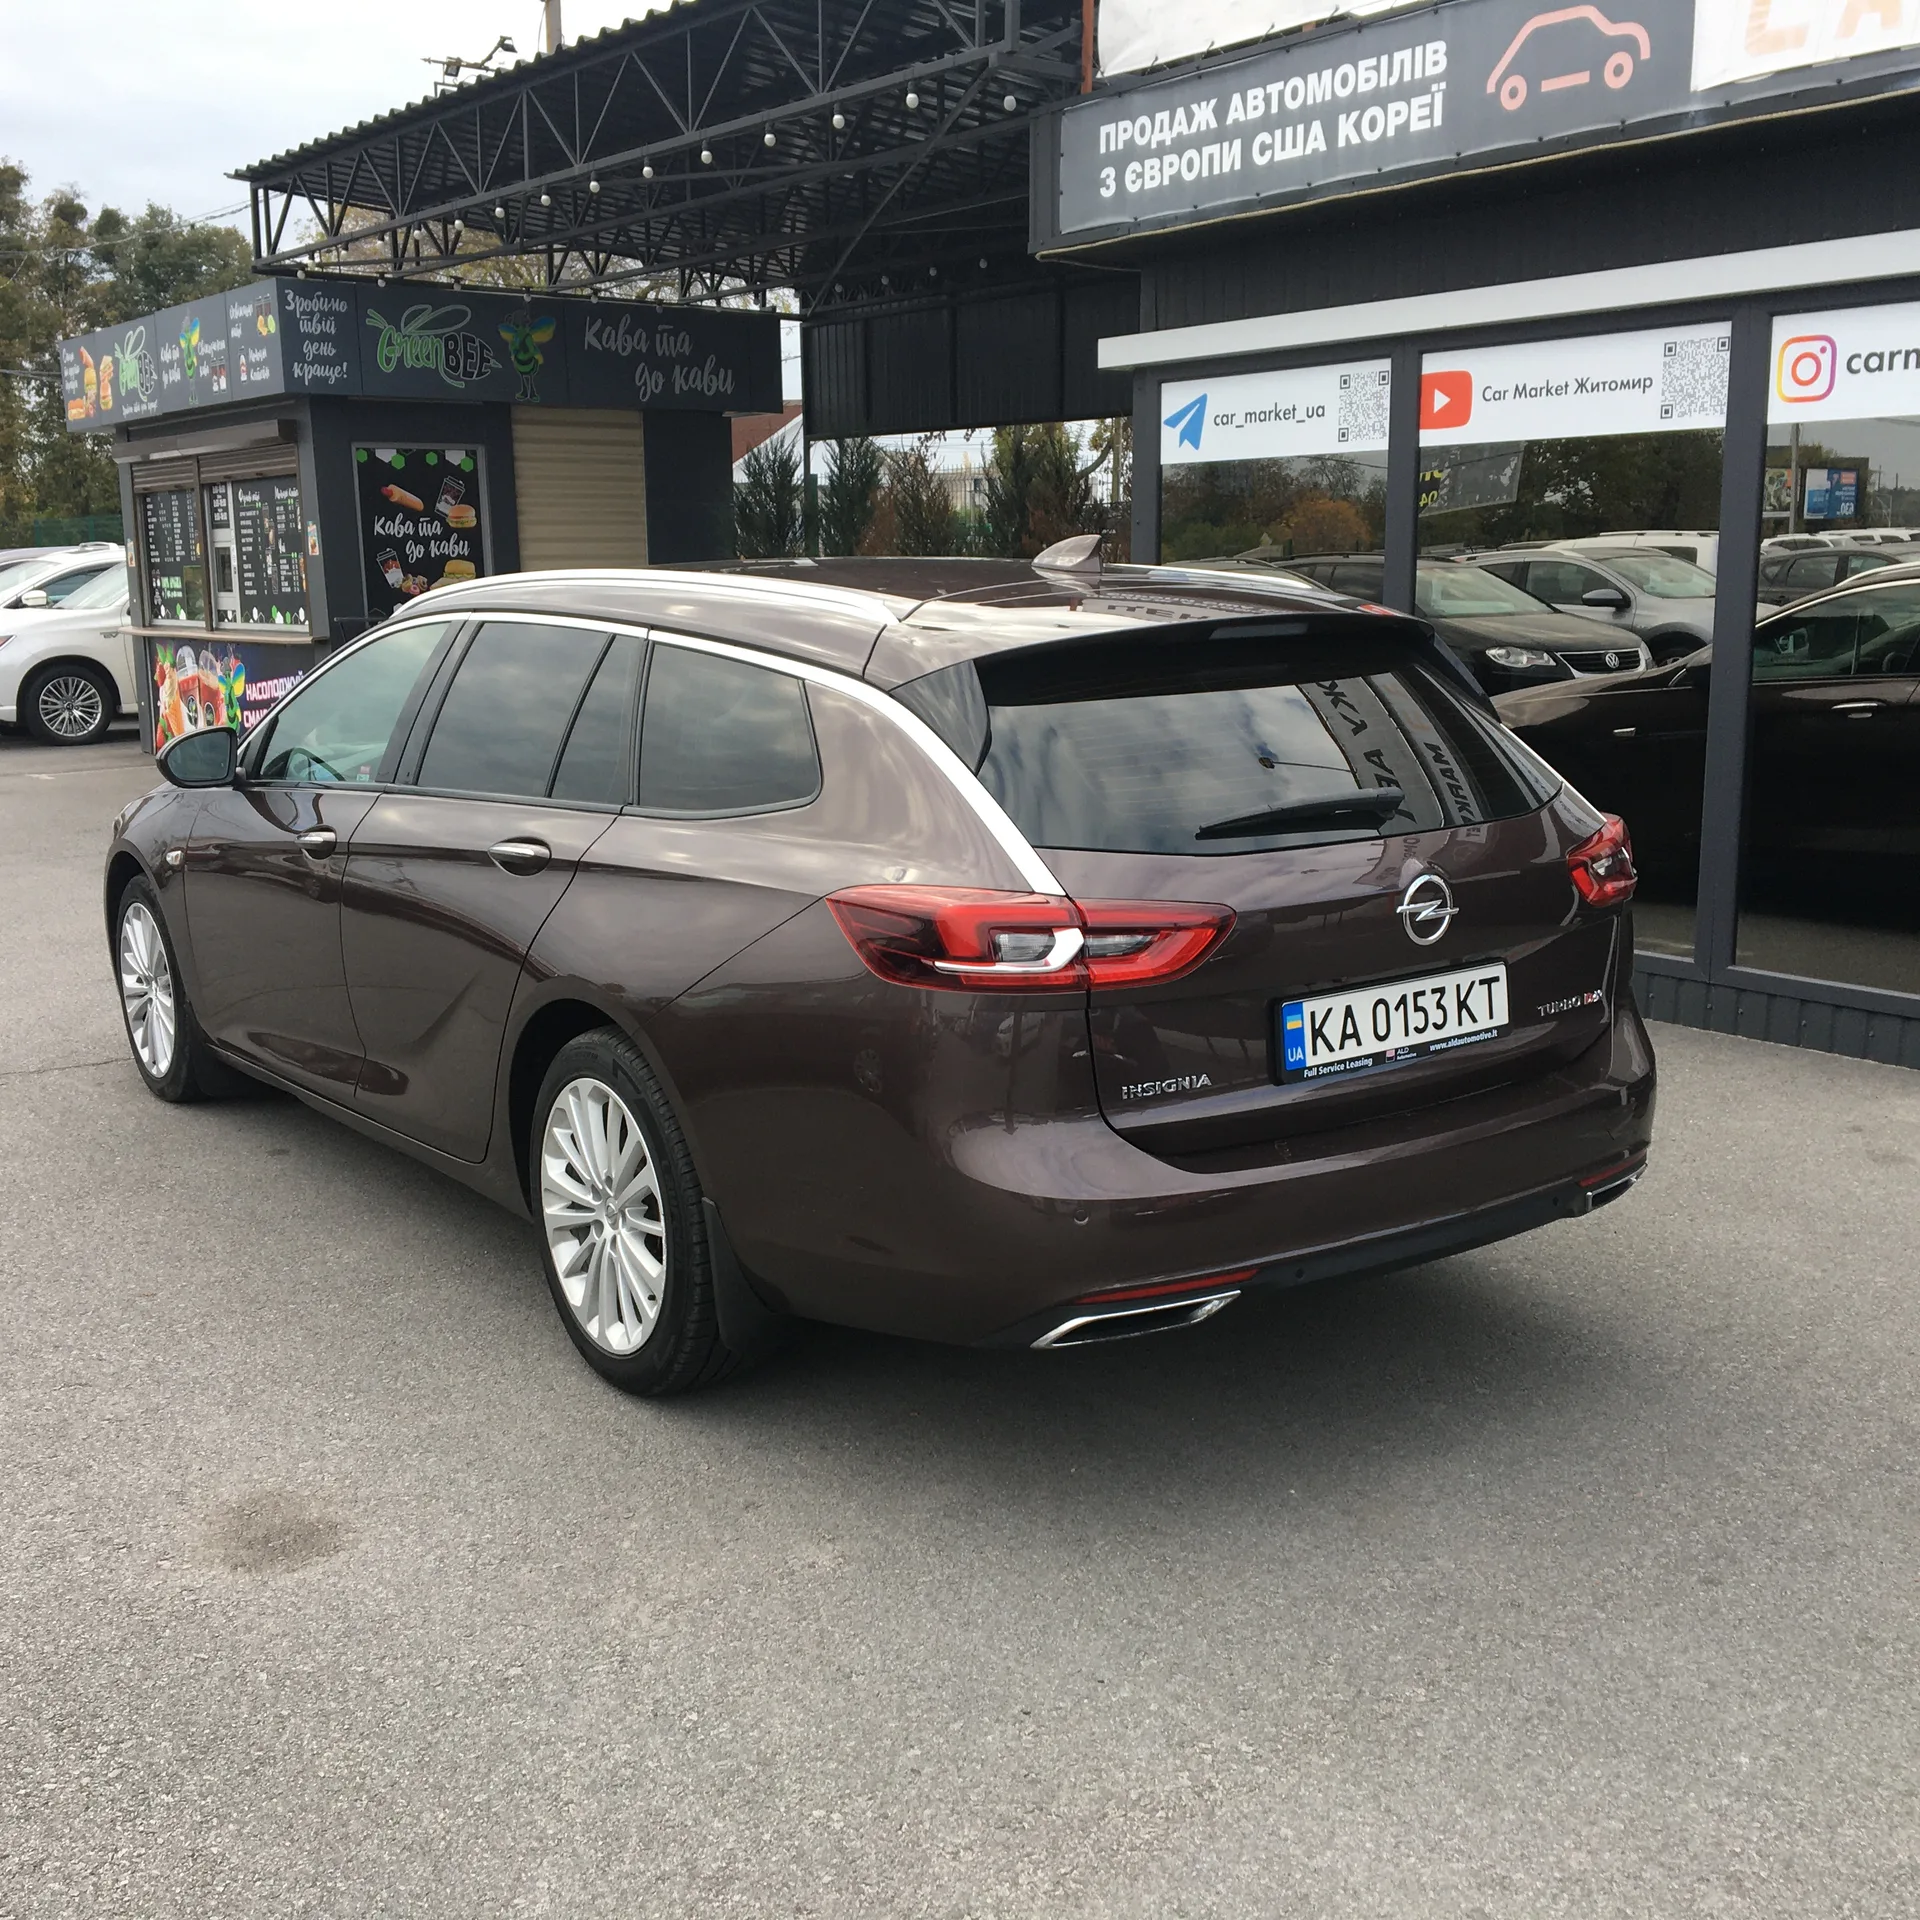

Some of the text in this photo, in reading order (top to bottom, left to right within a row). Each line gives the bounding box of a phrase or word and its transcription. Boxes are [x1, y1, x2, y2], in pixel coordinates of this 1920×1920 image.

[1100, 40, 1447, 153] ПРОДАЖ АВТОМОБІЛІВ
[1124, 138, 1241, 193] ЄВРОПИ
[1252, 120, 1327, 166] США
[1338, 81, 1447, 148] КОРЕЇ
[285, 289, 347, 318] Зробимо
[300, 313, 336, 335] твій
[585, 314, 694, 357] Кава та
[303, 339, 337, 361] день
[292, 362, 347, 385] краще!
[635, 354, 735, 401] до кави
[1482, 377, 1653, 402] Car Market Житомир
[1213, 402, 1325, 428] car_market_ua
[374, 512, 443, 538] Кава та
[406, 533, 470, 563] до кави
[1310, 976, 1501, 1056] KA 0153 KT
[1538, 995, 1581, 1016] TURBO
[1396, 1047, 1410, 1055] ALD
[1429, 1029, 1498, 1052] www.aldautomotive.lt
[1288, 1046, 1304, 1062] UA
[1304, 1057, 1373, 1079] Full Service Leasing
[1122, 1074, 1212, 1100] INSIGNIA
